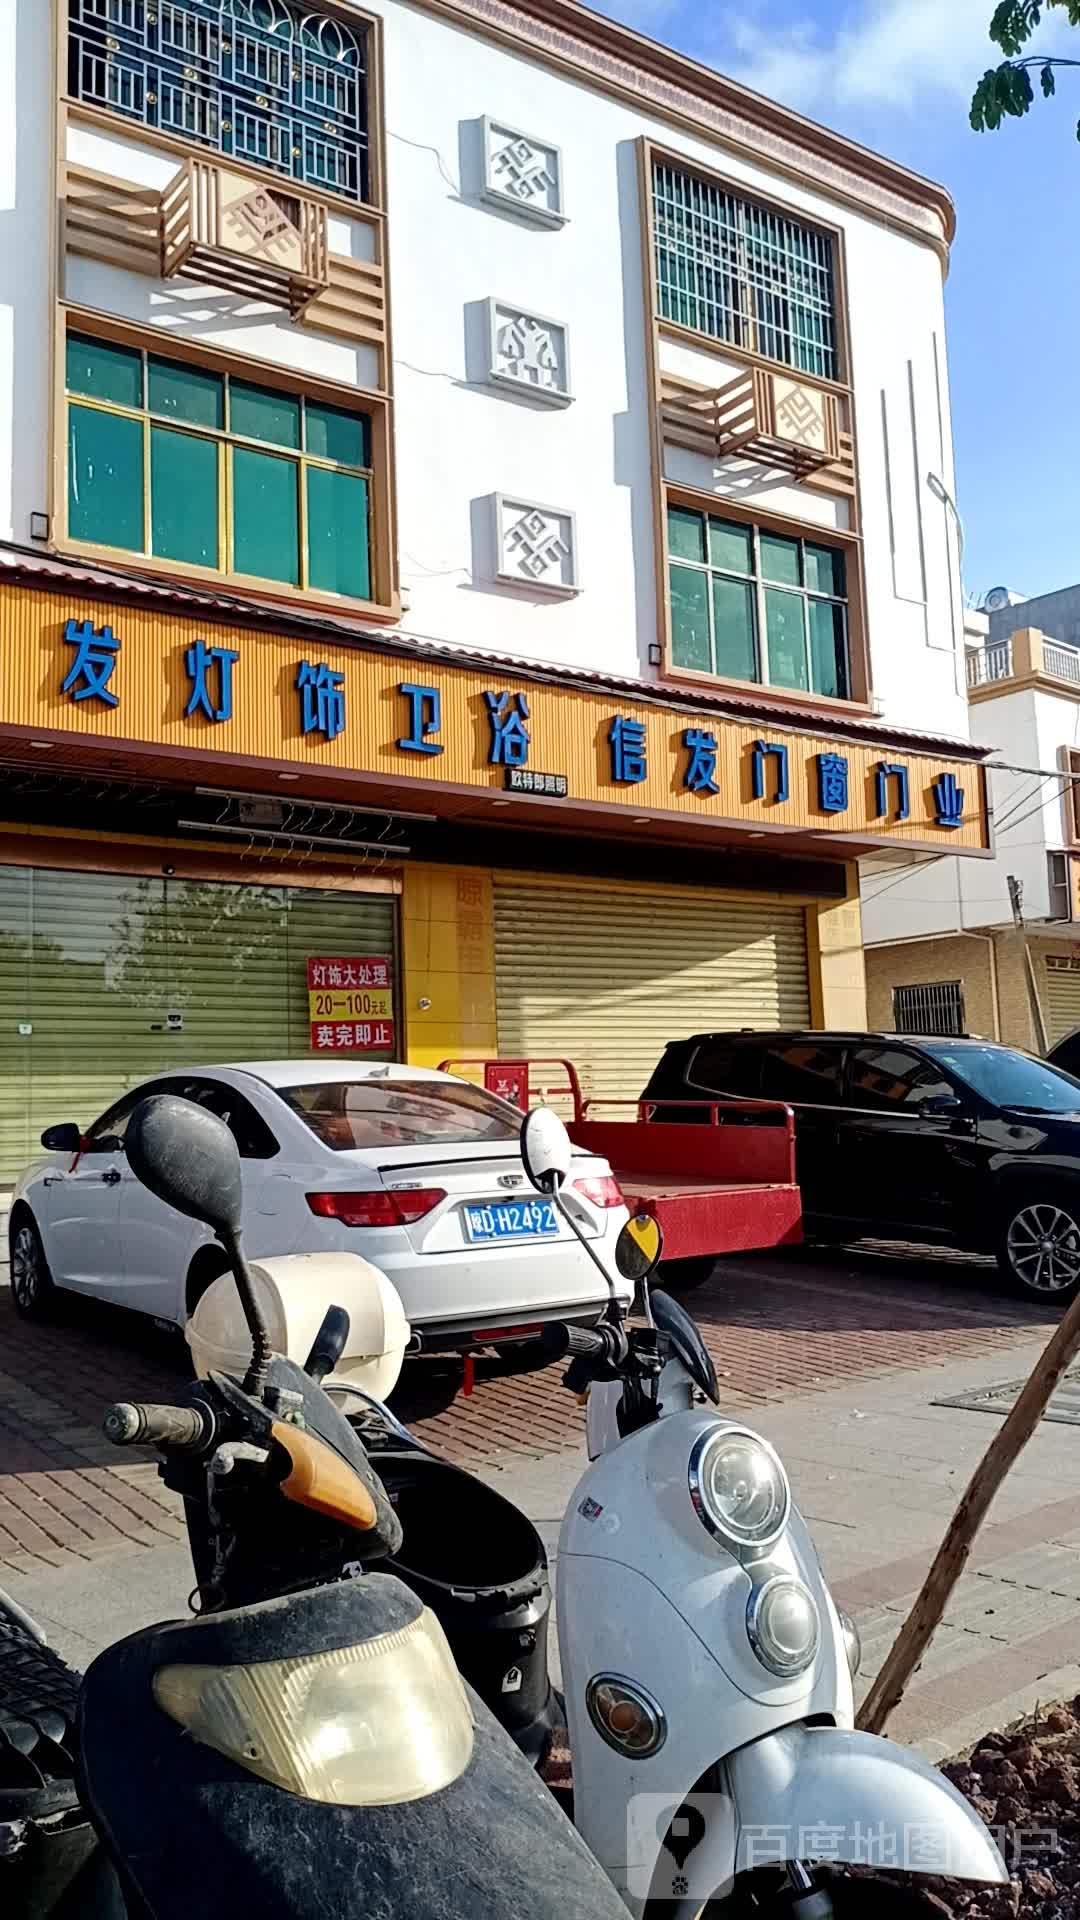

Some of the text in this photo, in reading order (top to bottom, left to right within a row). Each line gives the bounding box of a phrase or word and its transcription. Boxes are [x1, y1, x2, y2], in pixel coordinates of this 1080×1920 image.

[62, 618, 964, 827] 发灯饰卫浴 信发门窗门业
[312, 964, 388, 986] 灯饰大处理
[317, 1024, 391, 1047] 卖完即止
